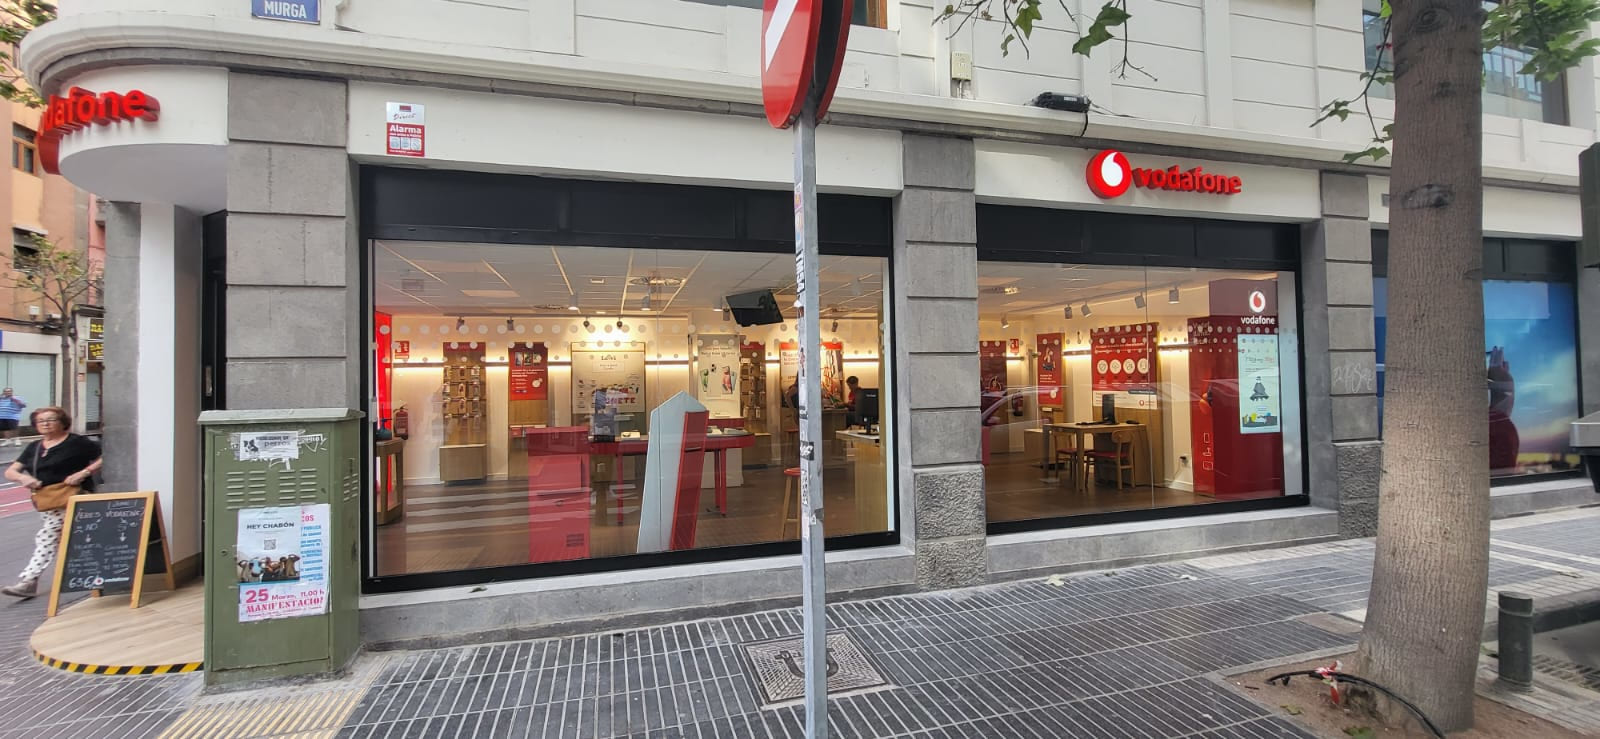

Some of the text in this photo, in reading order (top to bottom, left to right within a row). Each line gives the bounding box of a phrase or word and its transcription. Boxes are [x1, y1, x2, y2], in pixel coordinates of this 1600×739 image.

[264, 1, 307, 19] MURGA
[40, 86, 160, 136] dafone
[390, 124, 422, 134] Alarma
[1132, 165, 1242, 195] vodafone
[1240, 315, 1275, 325] vodafone
[245, 589, 269, 604] 25
